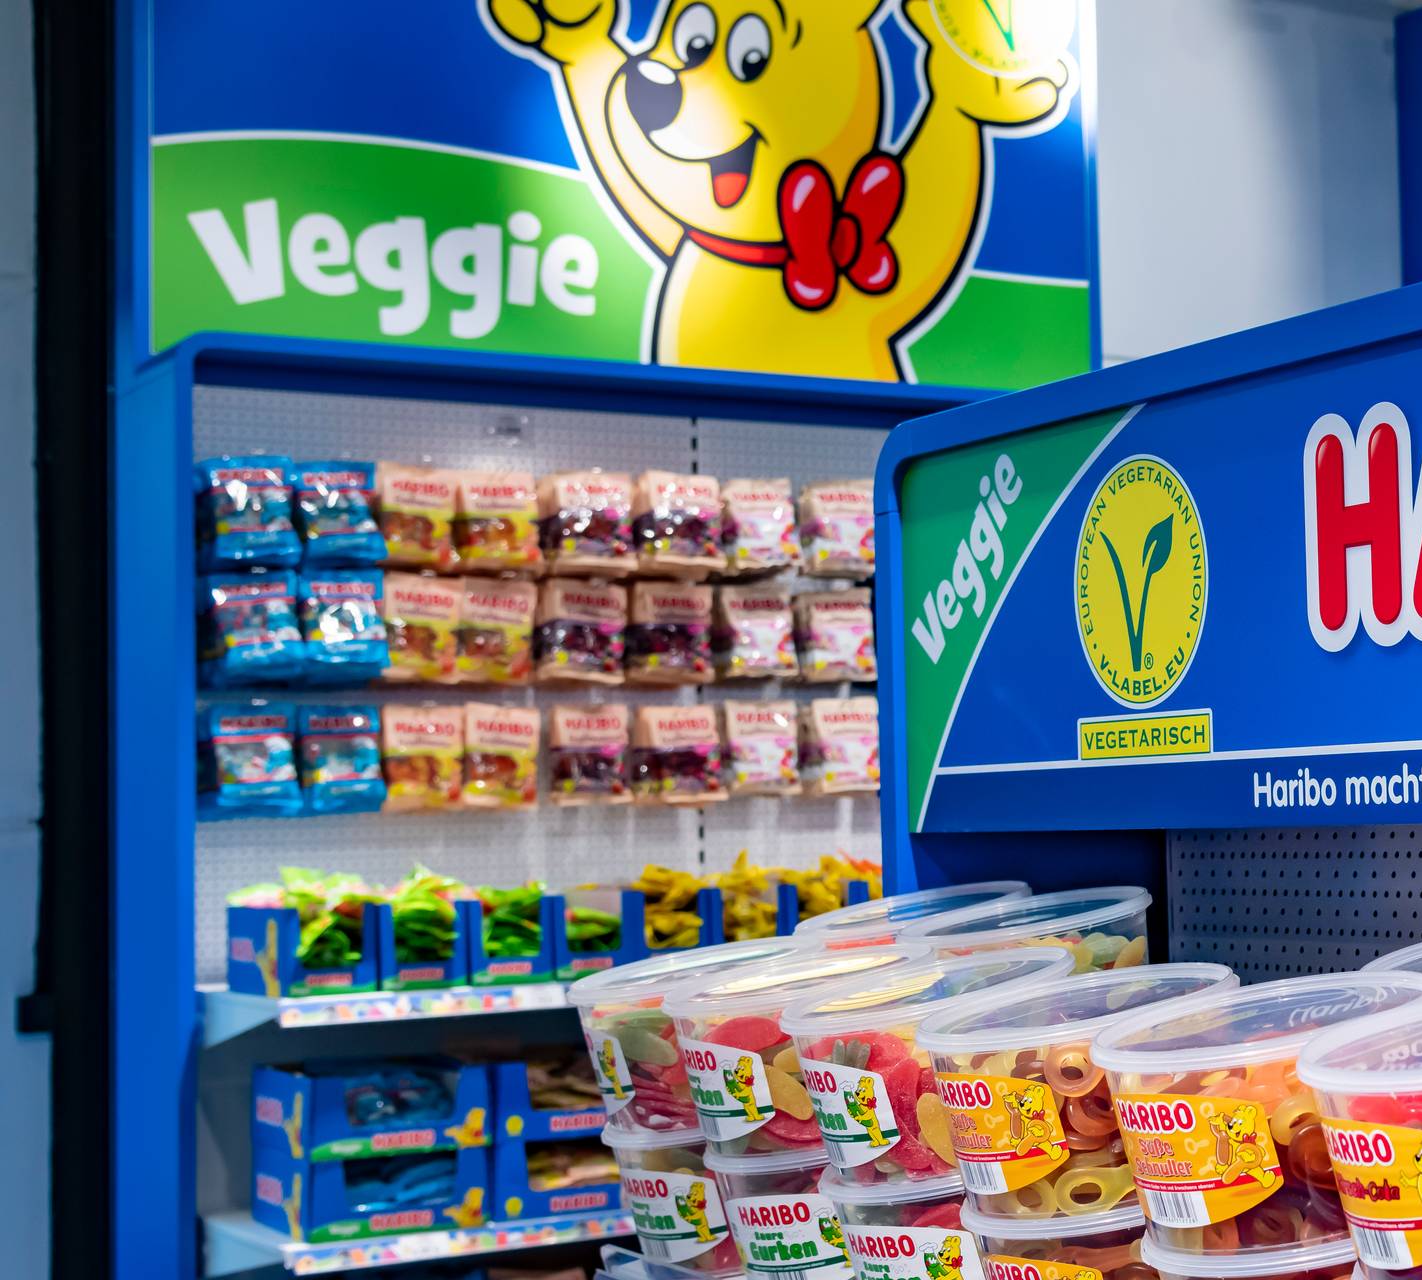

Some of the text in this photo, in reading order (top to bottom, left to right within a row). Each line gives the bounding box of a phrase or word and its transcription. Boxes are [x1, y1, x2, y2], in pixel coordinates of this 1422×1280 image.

[187, 199, 599, 339] Veggie
[911, 453, 1023, 665] Veggie
[1080, 466, 1202, 635] EUROPEAN VEGETARIAN UNION
[1100, 646, 1185, 696] V-LABEL.EU
[1084, 724, 1206, 750] VEGETARISCH
[1253, 766, 1337, 808] Haribo
[683, 1048, 717, 1072] RIBO
[802, 1069, 837, 1093] RIBO
[1117, 1101, 1195, 1133] HARIBO
[1139, 1138, 1175, 1158] Süße
[738, 1201, 811, 1227] HARIBO
[847, 1232, 916, 1258] HARIBO
